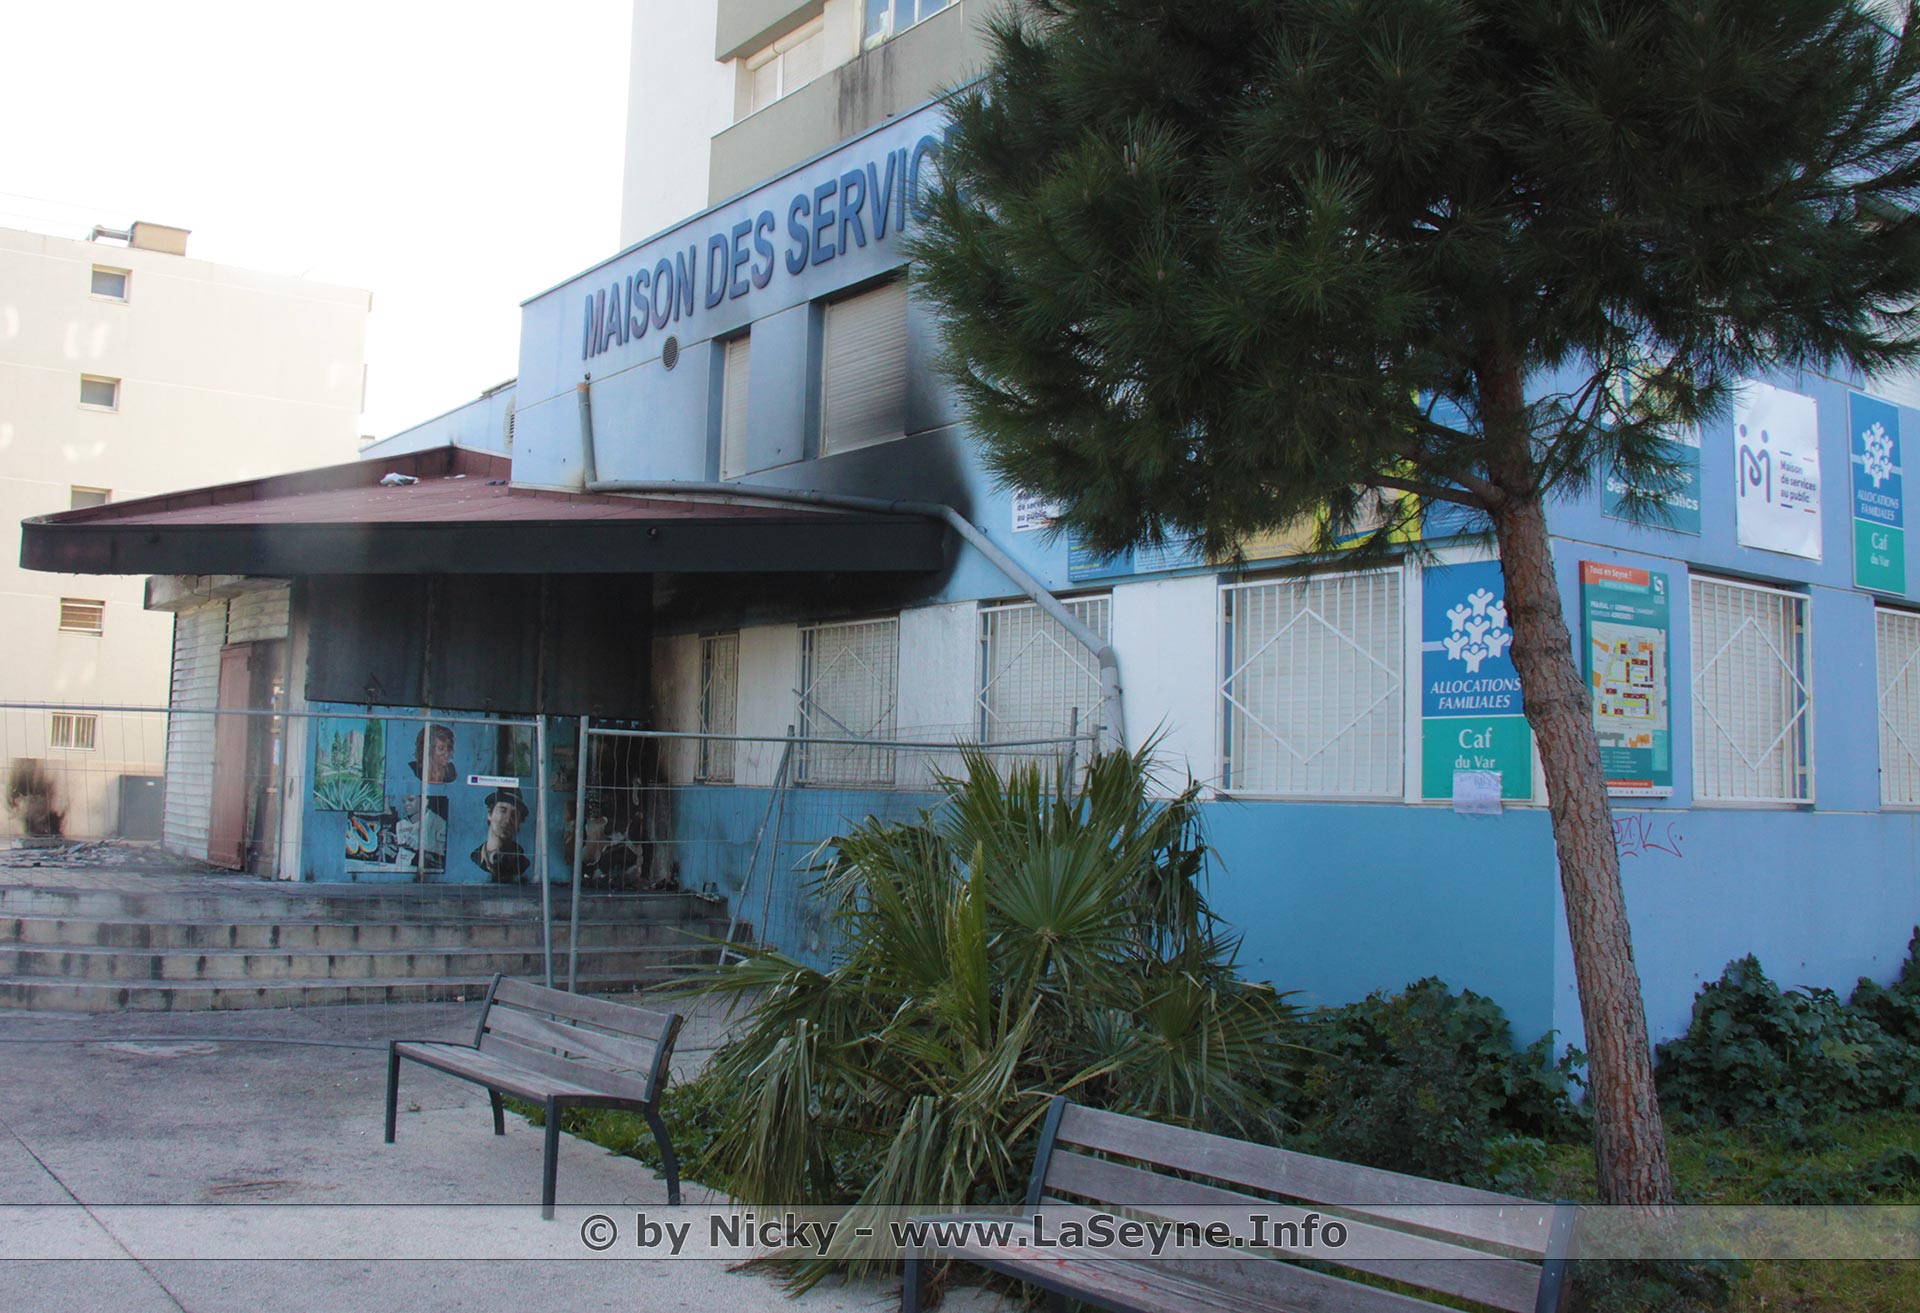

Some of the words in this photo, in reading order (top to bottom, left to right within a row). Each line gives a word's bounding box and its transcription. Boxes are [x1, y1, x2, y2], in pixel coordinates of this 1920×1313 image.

[581, 244, 696, 361] MAISON
[705, 209, 775, 310] DES
[784, 121, 962, 276] SERVIC
[1780, 460, 1803, 474] Maison
[1780, 474, 1789, 485] de
[1790, 478, 1816, 491] services
[1780, 489, 1789, 498] au
[1790, 491, 1810, 503] public
[1857, 489, 1900, 509] ALLOCATIONS
[1861, 503, 1895, 521] FAMILIALES
[1871, 532, 1889, 550] Caf
[1870, 553, 1879, 565] du
[1590, 565, 1603, 576] Tous
[1612, 568, 1629, 580] Seyne
[1430, 678, 1522, 694] ALLOCATIONS
[1438, 694, 1511, 710] FAMILIALES
[1458, 727, 1493, 749] Caf
[1455, 754, 1471, 769] du
[1474, 755, 1496, 769] Var
